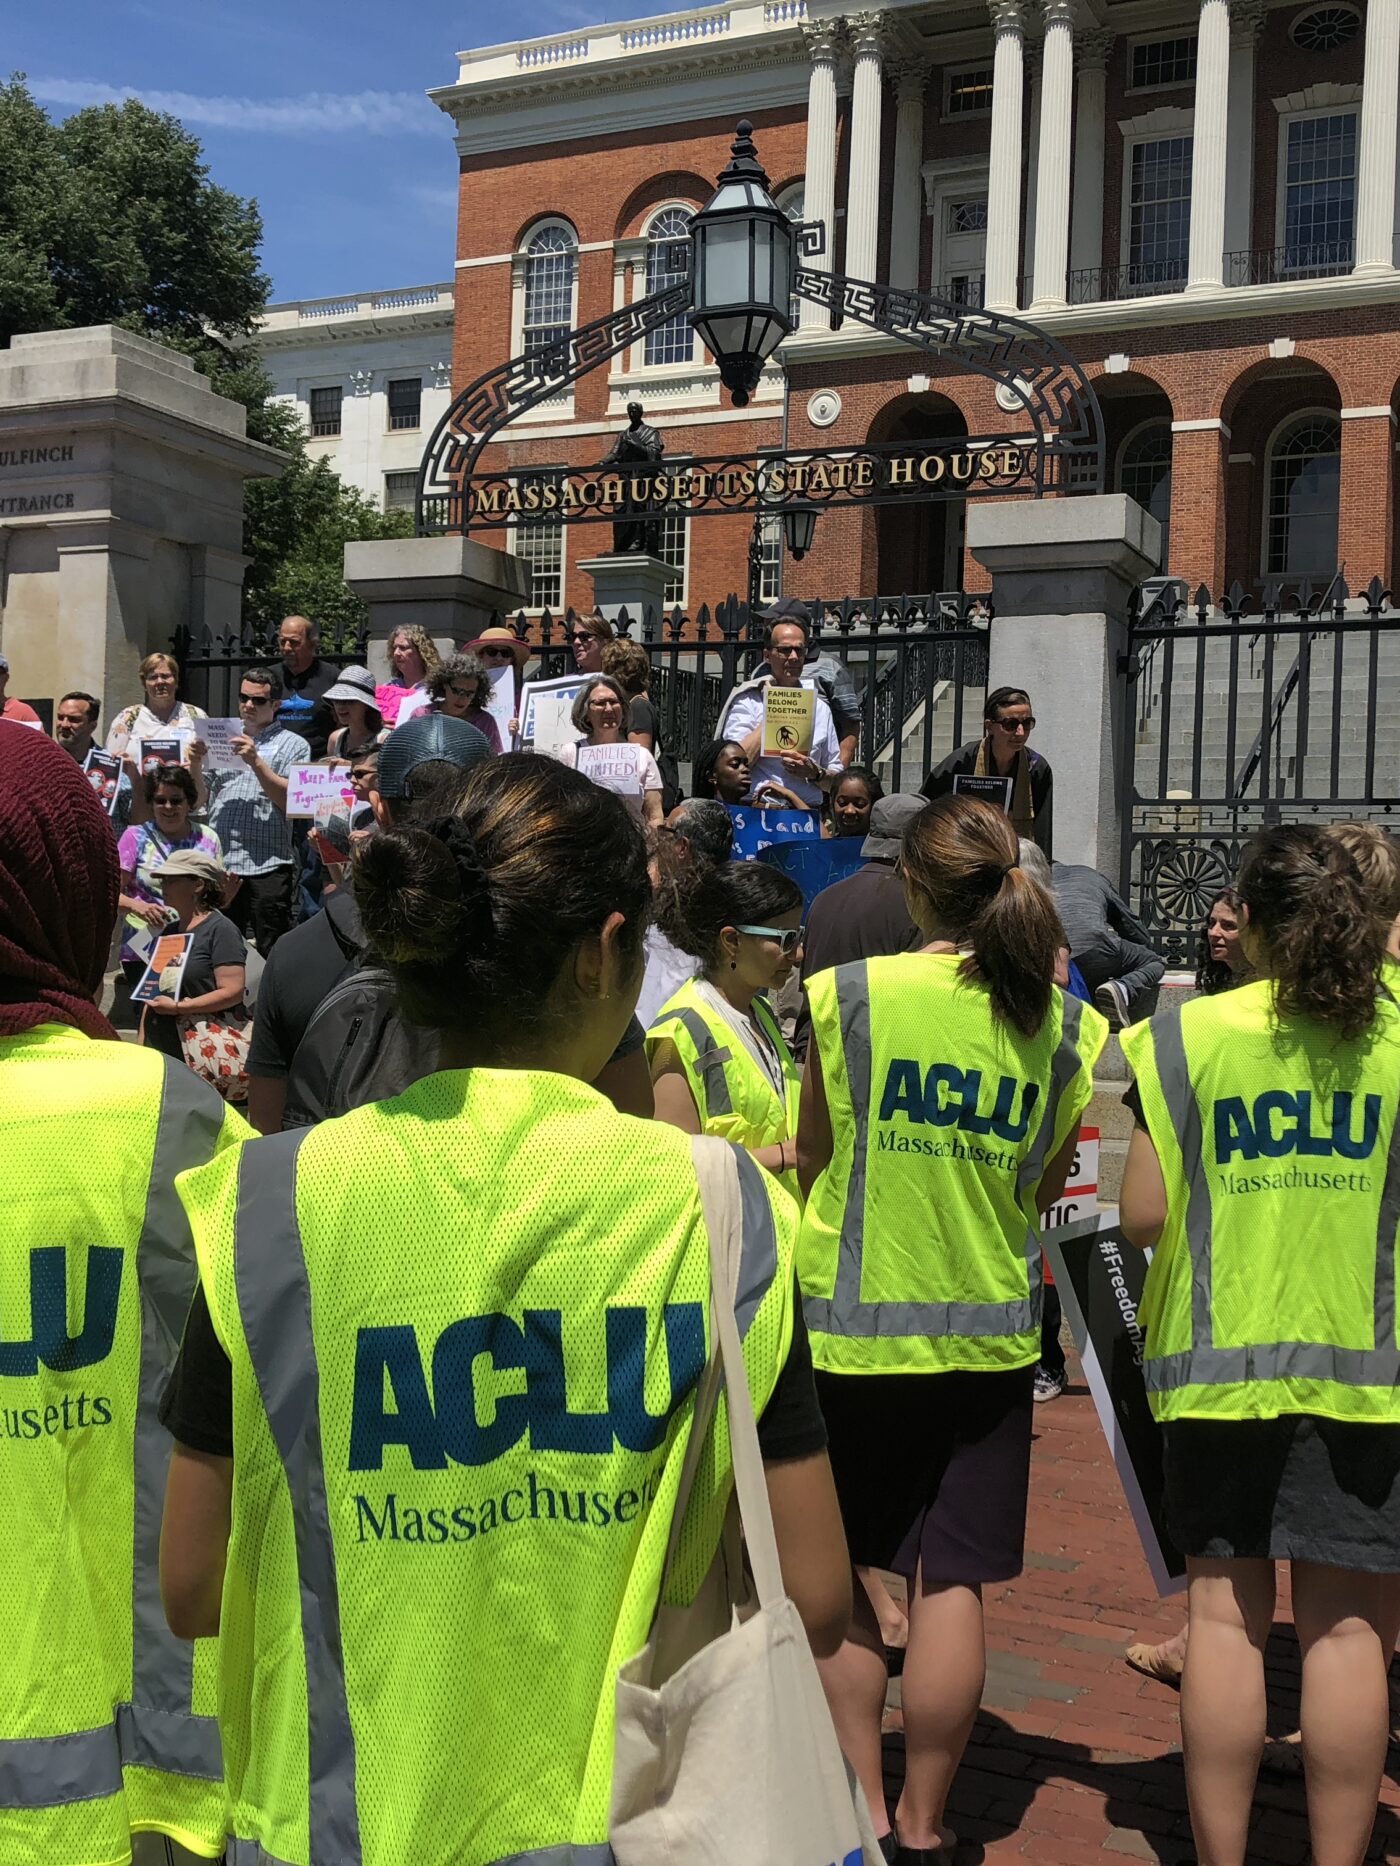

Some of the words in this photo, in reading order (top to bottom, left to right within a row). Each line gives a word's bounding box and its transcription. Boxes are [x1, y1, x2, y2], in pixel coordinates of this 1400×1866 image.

[0, 446, 74, 466] ULFINCH
[474, 471, 755, 512] MASSACHUSETTS
[770, 461, 874, 494] STATE
[888, 449, 1022, 484] HOUSE
[767, 690, 802, 698] FAMILIES
[767, 698, 798, 706] BELONG
[767, 706, 807, 715] TOGETHER
[581, 746, 637, 760] FAMILIES
[584, 762, 638, 779] UNITED!
[761, 810, 814, 834] Land
[878, 1058, 1040, 1143] ACLU
[1214, 1089, 1382, 1165] ACLU
[1068, 1150, 1081, 1177] S
[1219, 1165, 1373, 1197] Massachusetts
[1045, 1203, 1079, 1230] TIC
[1099, 1241, 1146, 1367] #FreedomAg
[349, 1301, 707, 1472] ACLU
[0, 1391, 112, 1440] usetts
